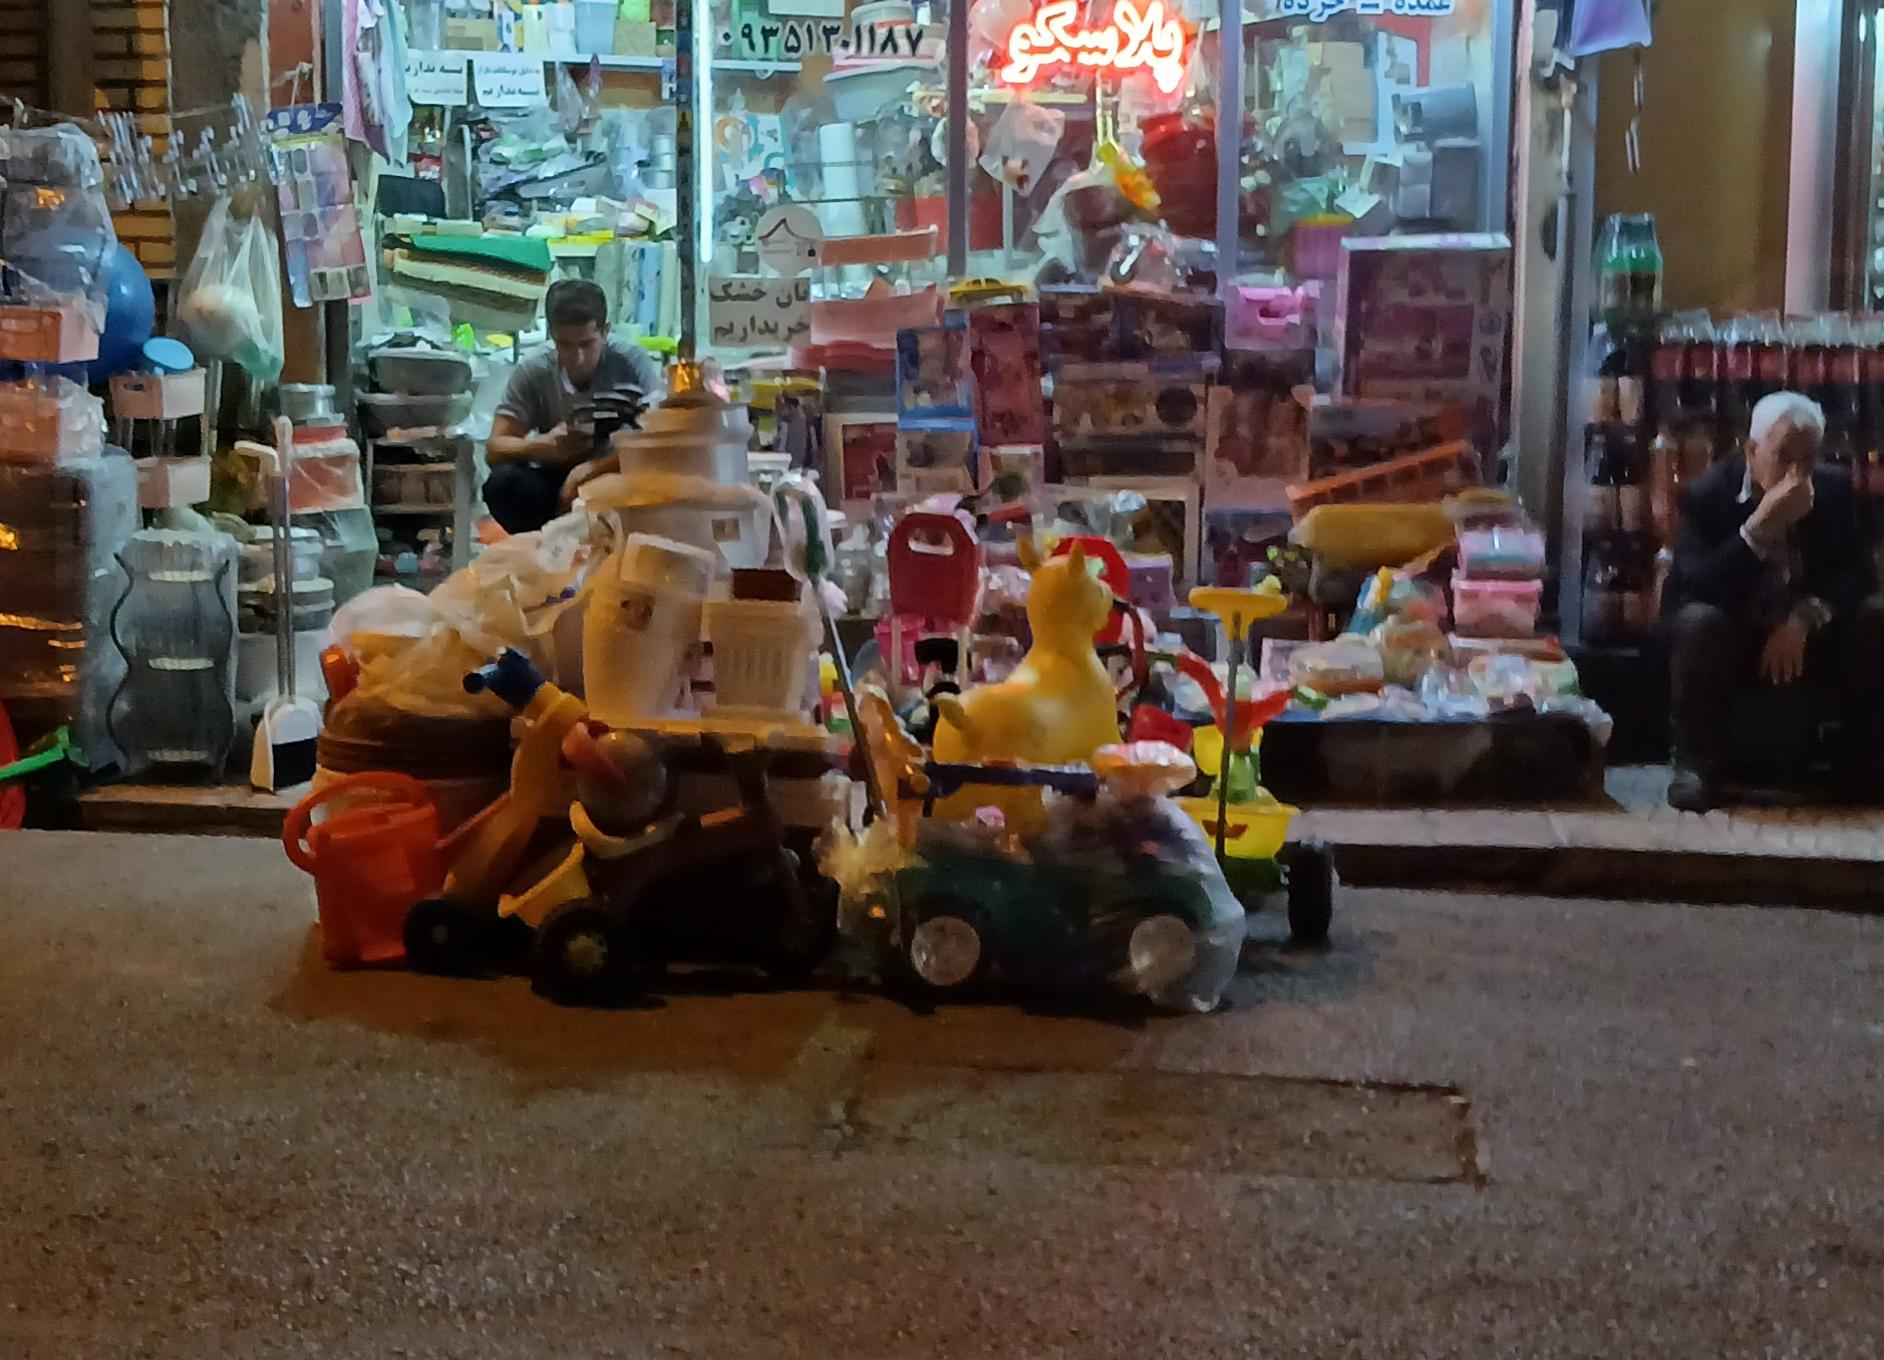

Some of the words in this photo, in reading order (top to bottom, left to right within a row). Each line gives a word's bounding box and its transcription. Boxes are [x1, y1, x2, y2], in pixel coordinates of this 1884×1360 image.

[722, 22, 924, 56] ۰۹۳۵۱۳۰۱۱۸۷
[1001, 0, 1184, 94] پلاسکو
[710, 281, 767, 302] خشک
[775, 281, 808, 309] نان
[714, 315, 810, 343] خریداریم
